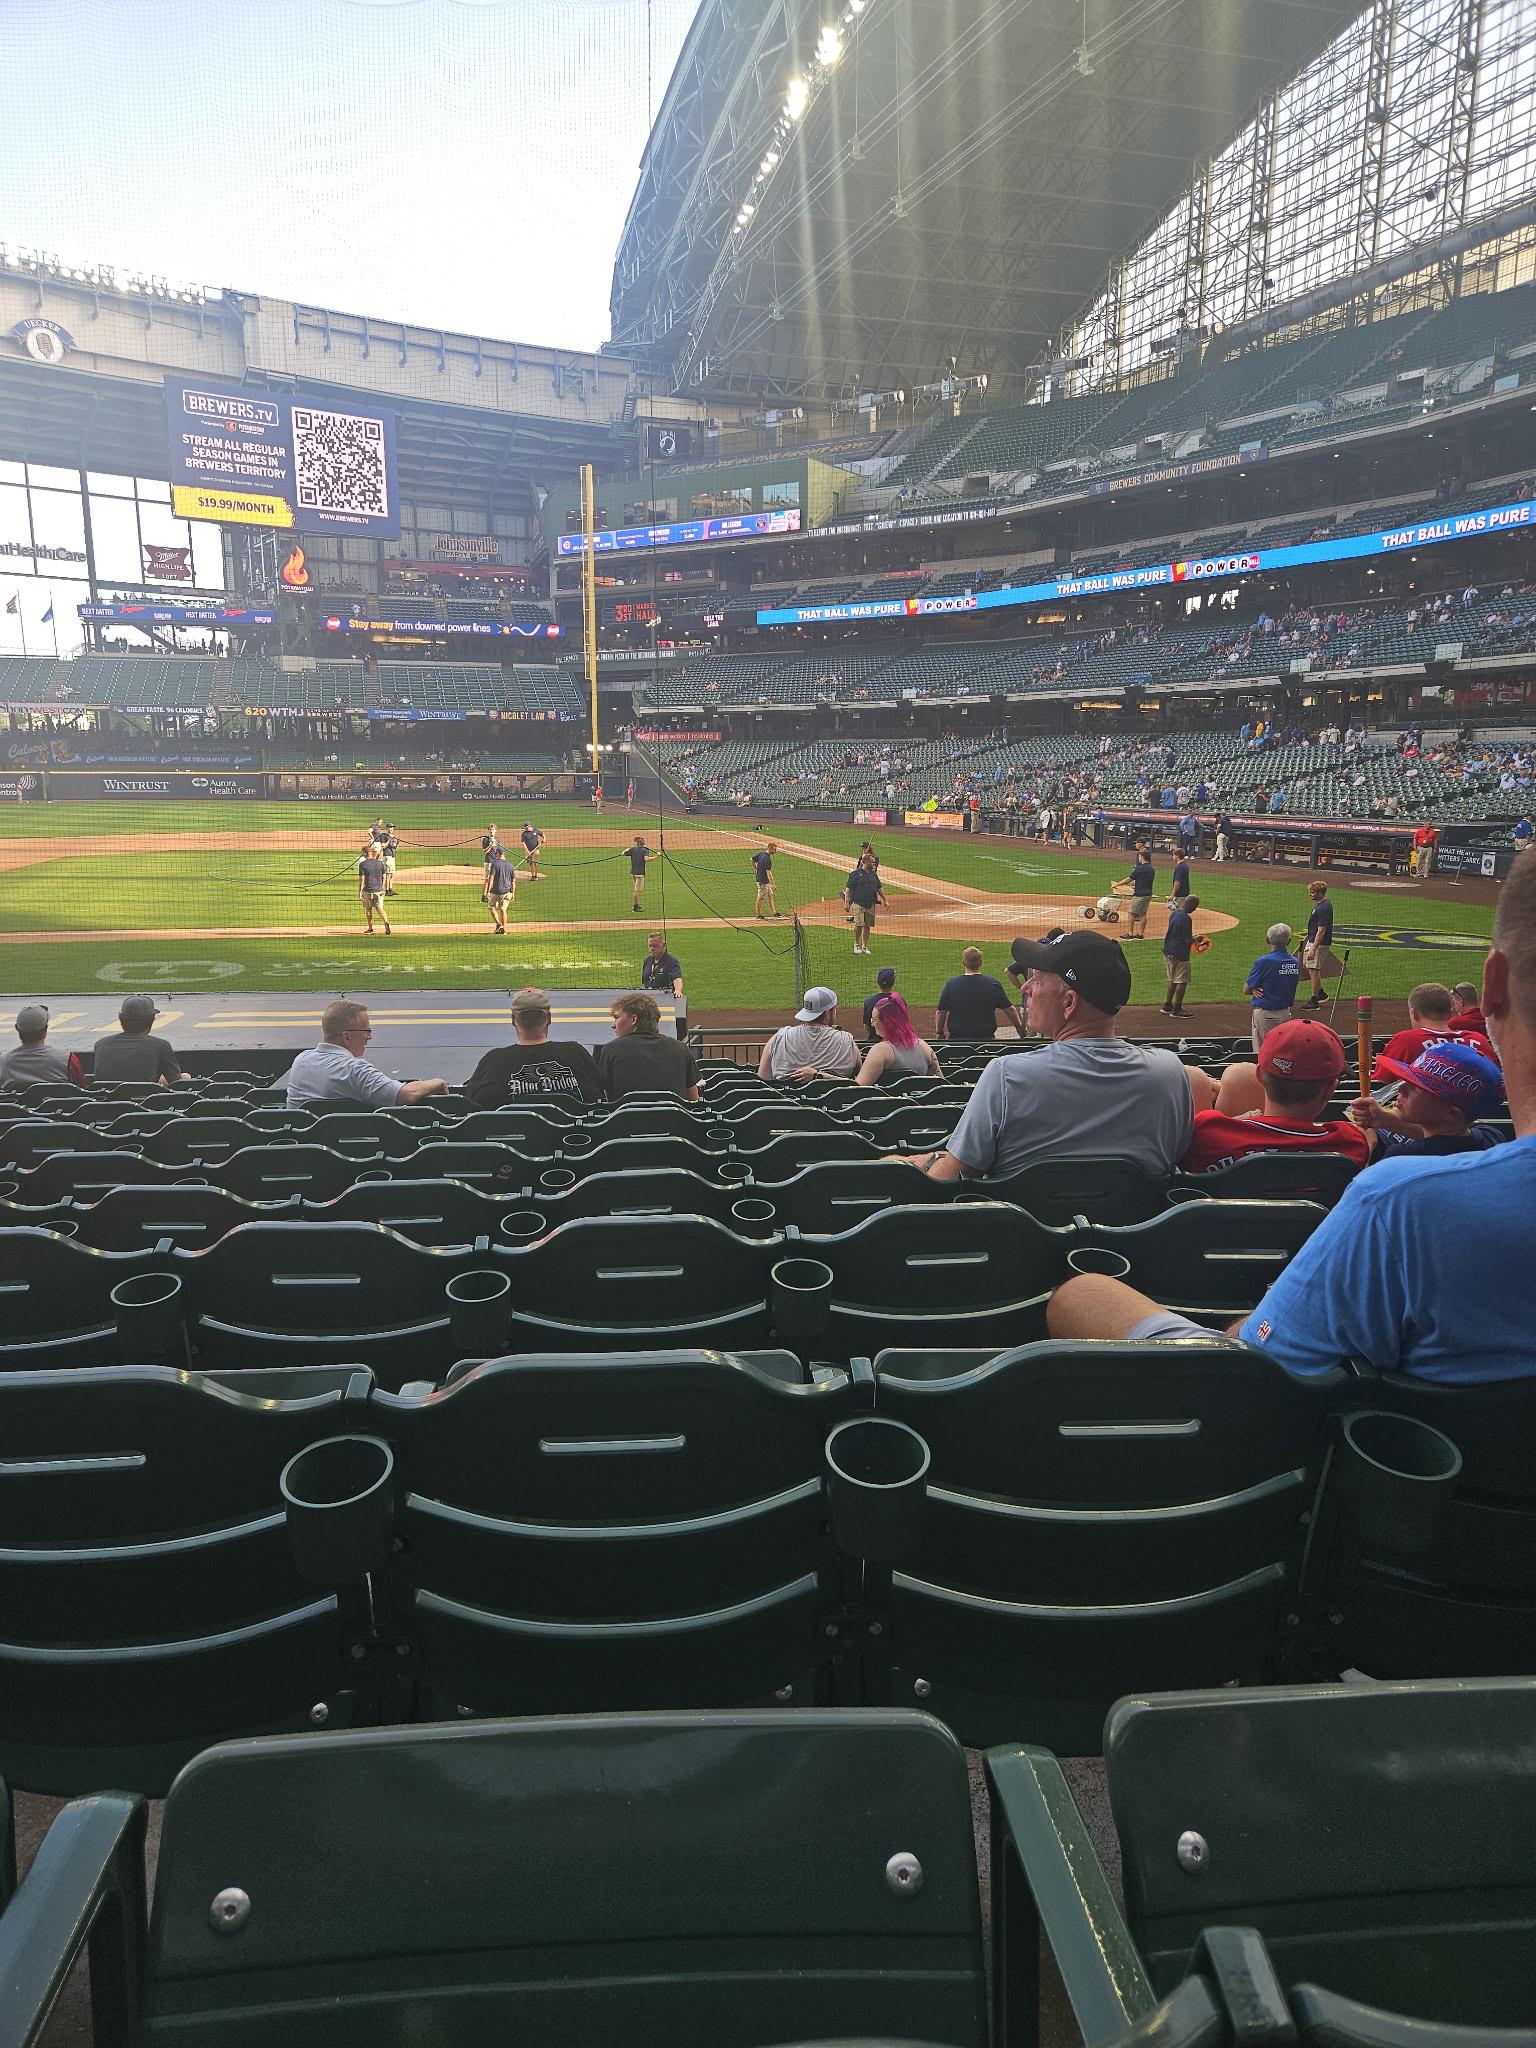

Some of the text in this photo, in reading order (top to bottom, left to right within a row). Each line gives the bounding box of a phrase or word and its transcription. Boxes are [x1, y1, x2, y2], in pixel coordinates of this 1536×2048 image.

[188, 395, 273, 421] BREWERS.TV
[182, 433, 286, 457] STREAM ALL REGULAR
[192, 447, 278, 467] SEASON GAMES IN
[185, 457, 287, 479] BREWERS TERRITORY
[1109, 453, 1241, 491] BREWERS COMMUNITY FOUNDATION
[197, 496, 275, 514] $19.99/MONTH
[1382, 507, 1530, 548] THAT BALL WAS PURE
[434, 533, 499, 554] Johnsonville
[8, 541, 55, 560] Health
[56, 547, 87, 562] Care
[155, 551, 180, 563] Miller
[153, 562, 184, 571] HIGH LIFE
[1056, 583, 1083, 595] THAT
[1084, 579, 1110, 591] BALL
[1112, 574, 1135, 587] WAS
[1137, 569, 1167, 584] PURE
[81, 607, 95, 615] NEXT
[185, 611, 198, 619] NEXT
[798, 610, 823, 619] THAT
[824, 608, 848, 618] BALL
[850, 606, 872, 616] WAS
[874, 605, 901, 614] PURE
[349, 618, 370, 630] Stay
[370, 621, 394, 631] away
[394, 620, 413, 630] from
[414, 621, 446, 631] downed
[447, 625, 471, 633] power
[472, 623, 491, 632] lines
[244, 707, 304, 717] 620 WTMJ
[419, 710, 461, 719] WINTRUST
[500, 711, 545, 720] NICOLET LAW
[103, 779, 169, 790] WINTRUST
[209, 779, 237, 787] Aurora
[209, 787, 256, 795] Health Care
[1438, 847, 1455, 855] WHAT
[1438, 854, 1460, 862] HITTERS
[1419, 1057, 1481, 1096] CHICAGO
[508, 1075, 579, 1096] Alter Bridge
